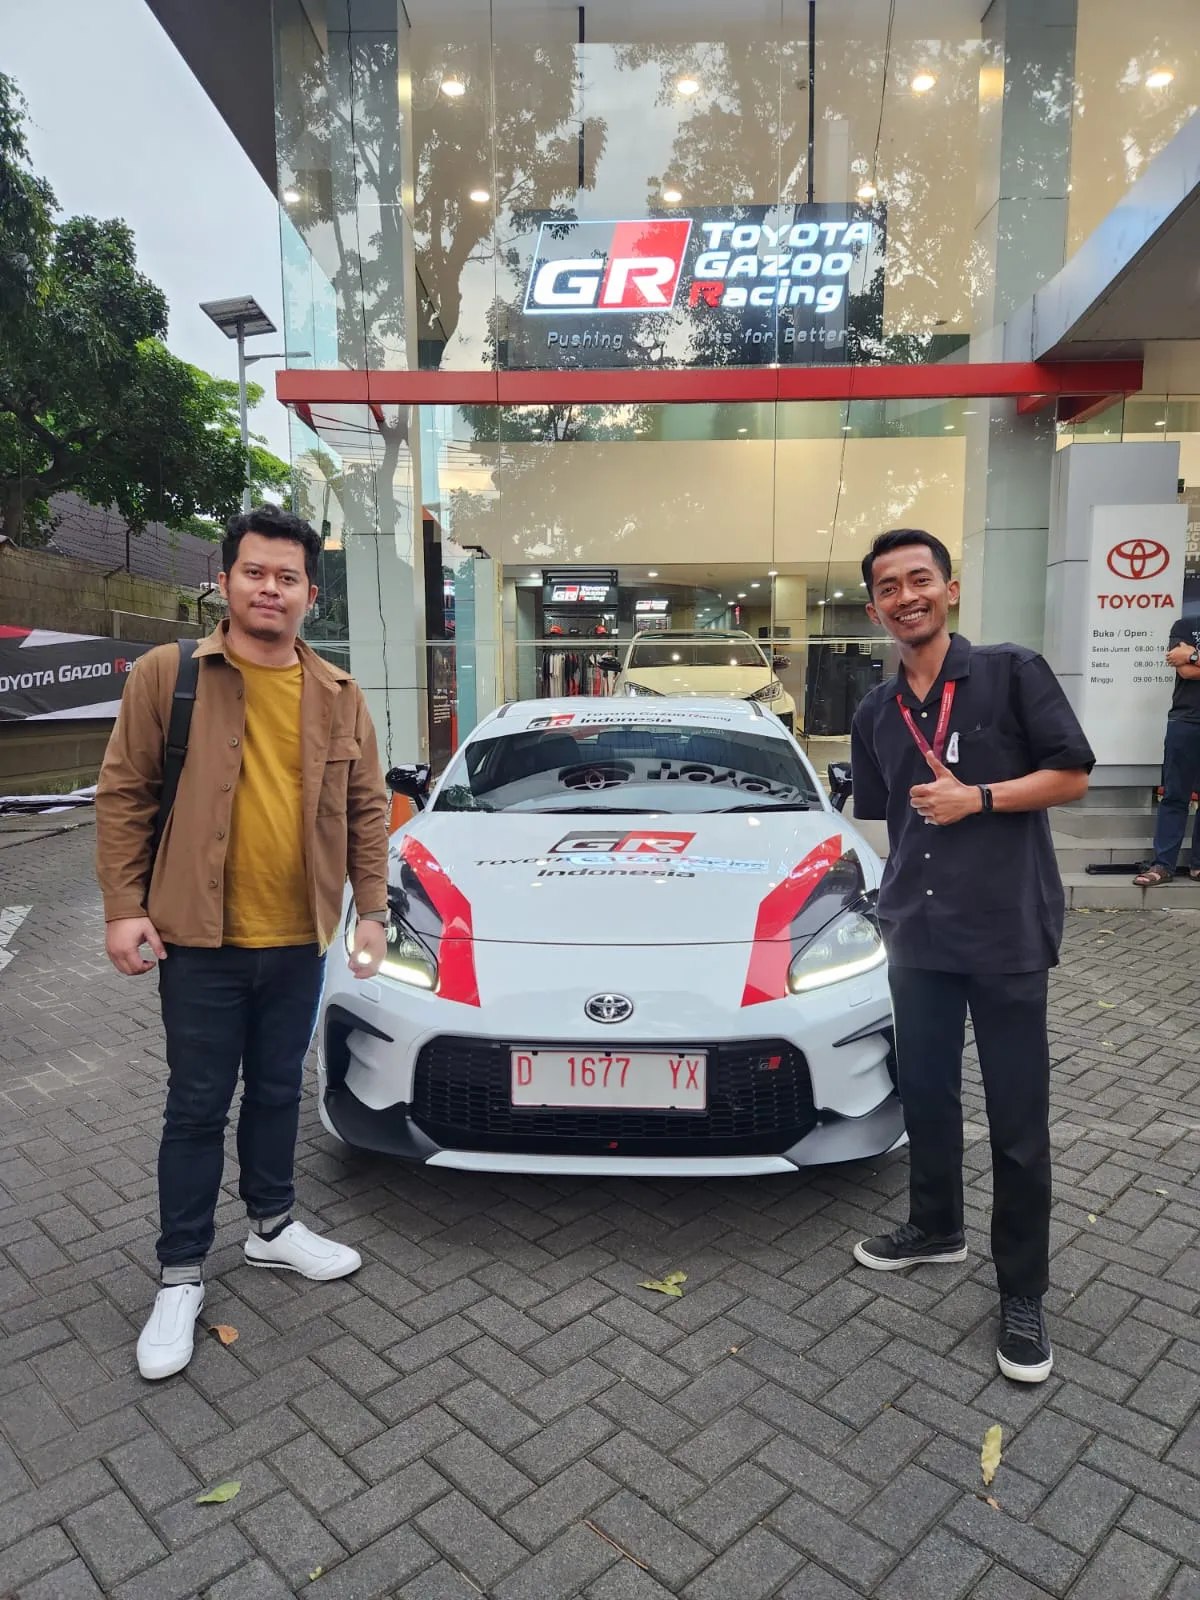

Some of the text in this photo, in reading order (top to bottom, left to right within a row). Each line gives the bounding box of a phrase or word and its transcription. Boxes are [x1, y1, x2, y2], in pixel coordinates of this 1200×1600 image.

[701, 221, 873, 249] TOYOTA
[693, 251, 854, 278] GAZOO
[532, 255, 676, 306] GR
[688, 278, 844, 314] Racing
[547, 331, 624, 350] Pushing
[744, 328, 774, 345] for
[784, 326, 848, 344] Better
[1097, 593, 1175, 609] TOYOTA
[1093, 629, 1115, 638] Buka
[1124, 629, 1148, 639] Open
[58, 662, 112, 683] GAZOO
[1090, 676, 1114, 684] Minggu
[580, 716, 673, 724] Indonesia
[551, 837, 687, 854] GR
[537, 867, 696, 878] Indonesia
[517, 1055, 701, 1090] D 1677 YX
